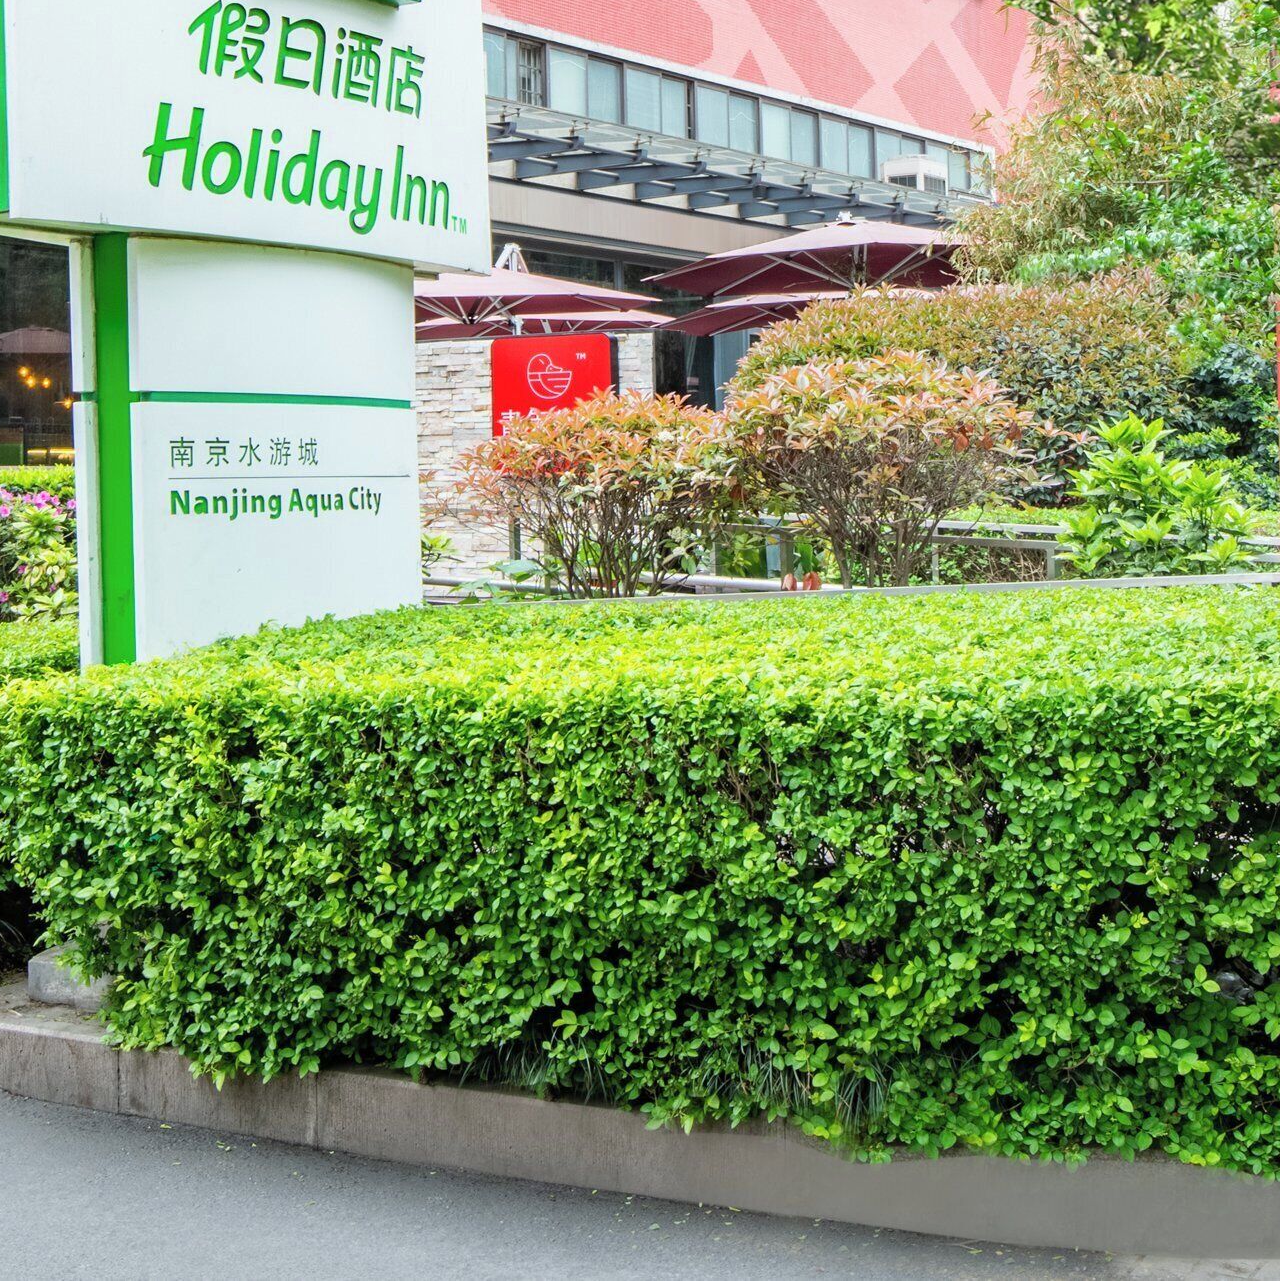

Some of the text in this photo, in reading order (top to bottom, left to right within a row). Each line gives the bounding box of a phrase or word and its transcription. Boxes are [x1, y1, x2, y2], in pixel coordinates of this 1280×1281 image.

[188, 0, 425, 119] 假日酒店
[143, 102, 383, 235] Holiday
[391, 144, 450, 230] Inn
[169, 436, 319, 468] 南京水游城
[169, 485, 383, 521] Nanjing Aqua City
